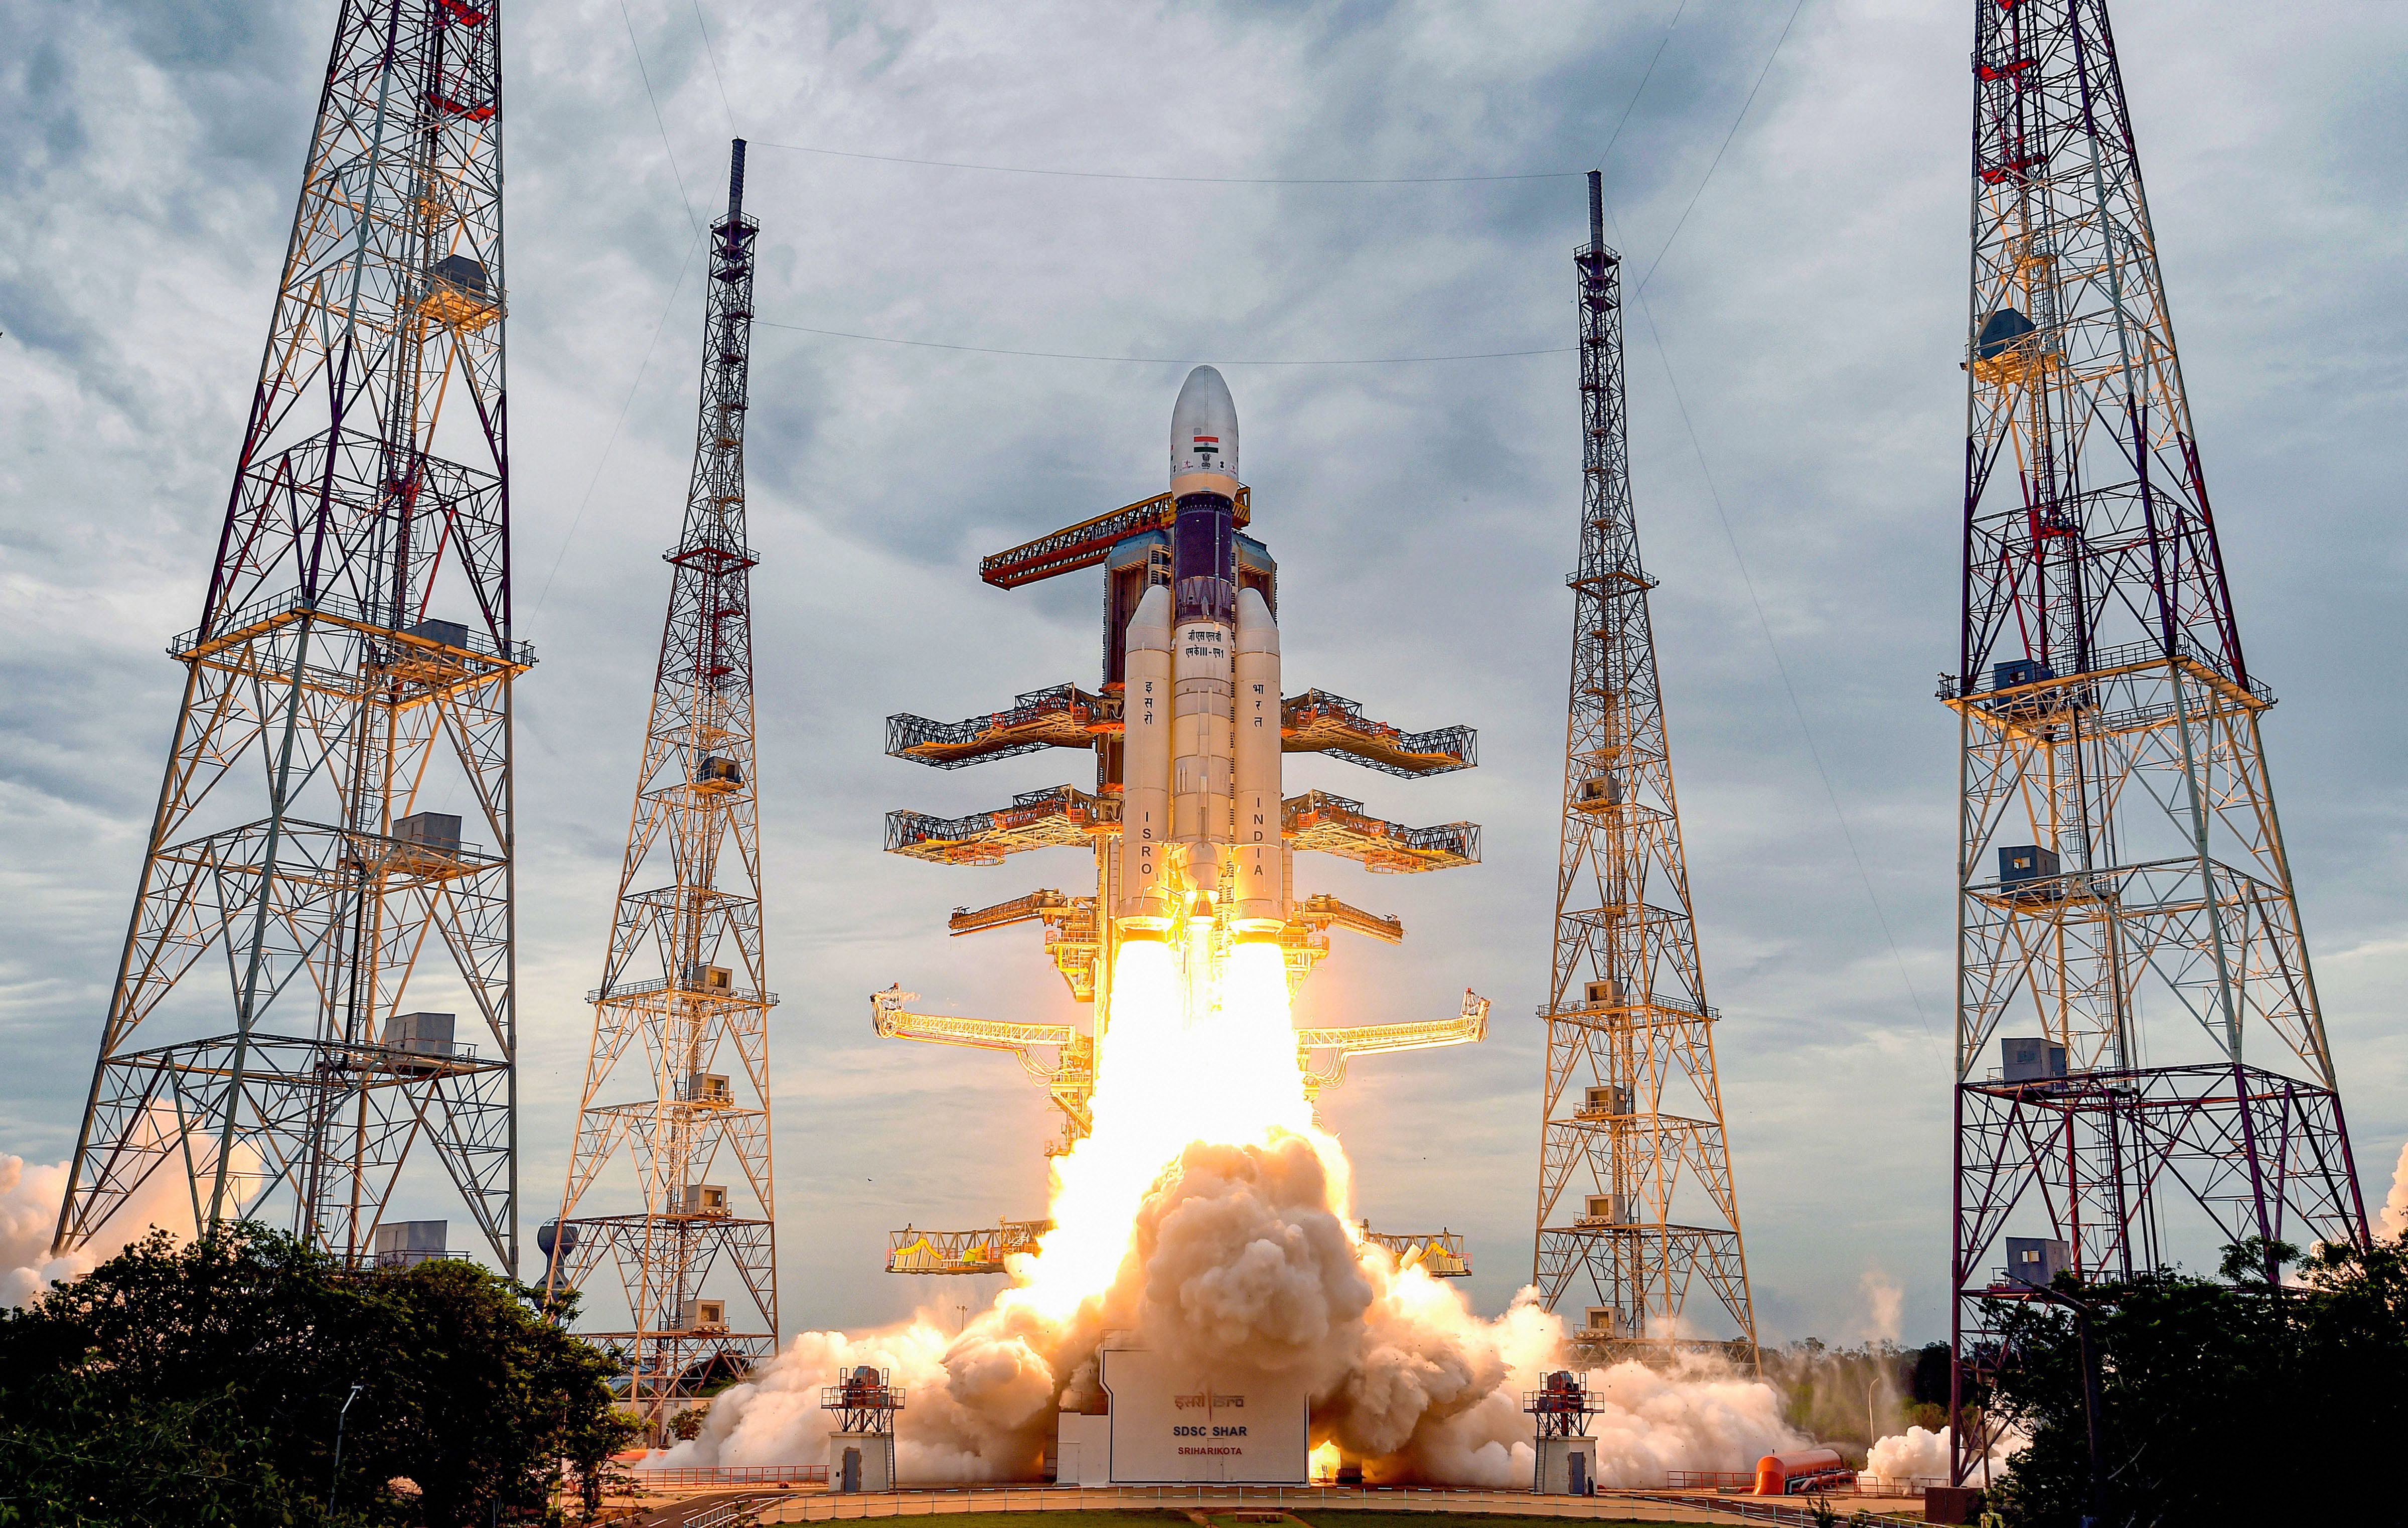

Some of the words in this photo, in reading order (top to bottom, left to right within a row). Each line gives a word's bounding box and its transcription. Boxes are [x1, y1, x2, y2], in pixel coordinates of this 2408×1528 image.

[1141, 811, 1152, 874] ISRO
[1254, 797, 1264, 876] INDIA
[1173, 1427, 1207, 1436] SDSC
[1213, 1427, 1247, 1436] SHAR
[1178, 1447, 1242, 1455] SRIHARIKOTA
